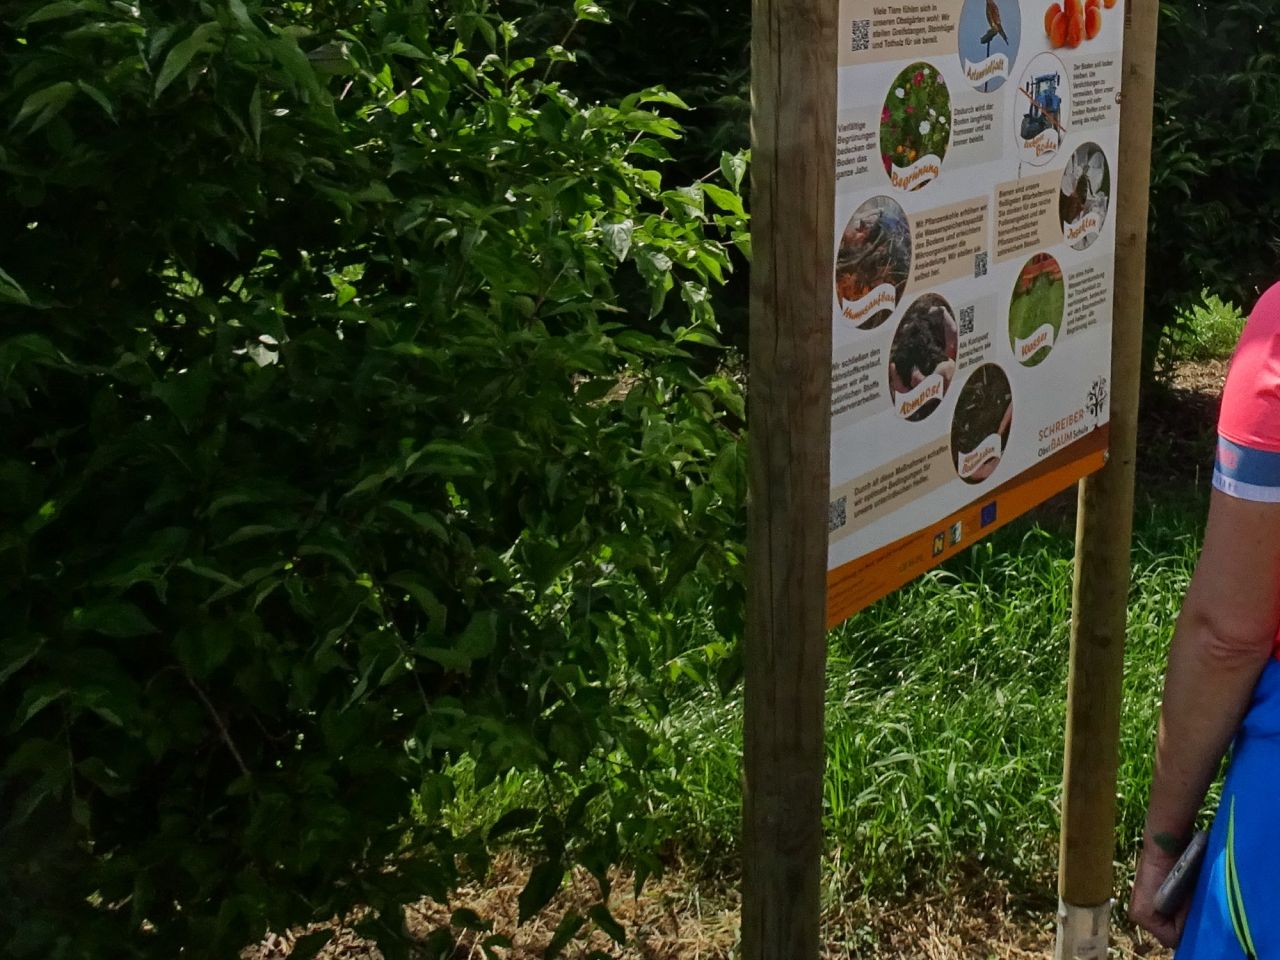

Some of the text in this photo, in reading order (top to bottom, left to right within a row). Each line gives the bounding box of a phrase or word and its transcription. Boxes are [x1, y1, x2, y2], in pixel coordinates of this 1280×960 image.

[873, 7, 887, 15] Viele
[920, 4, 931, 12] sich
[932, 4, 937, 12] in
[873, 41, 883, 49] und
[954, 117, 969, 126] Boden
[892, 163, 939, 190] Begrünung
[1039, 408, 1085, 441] SCHREIBER
